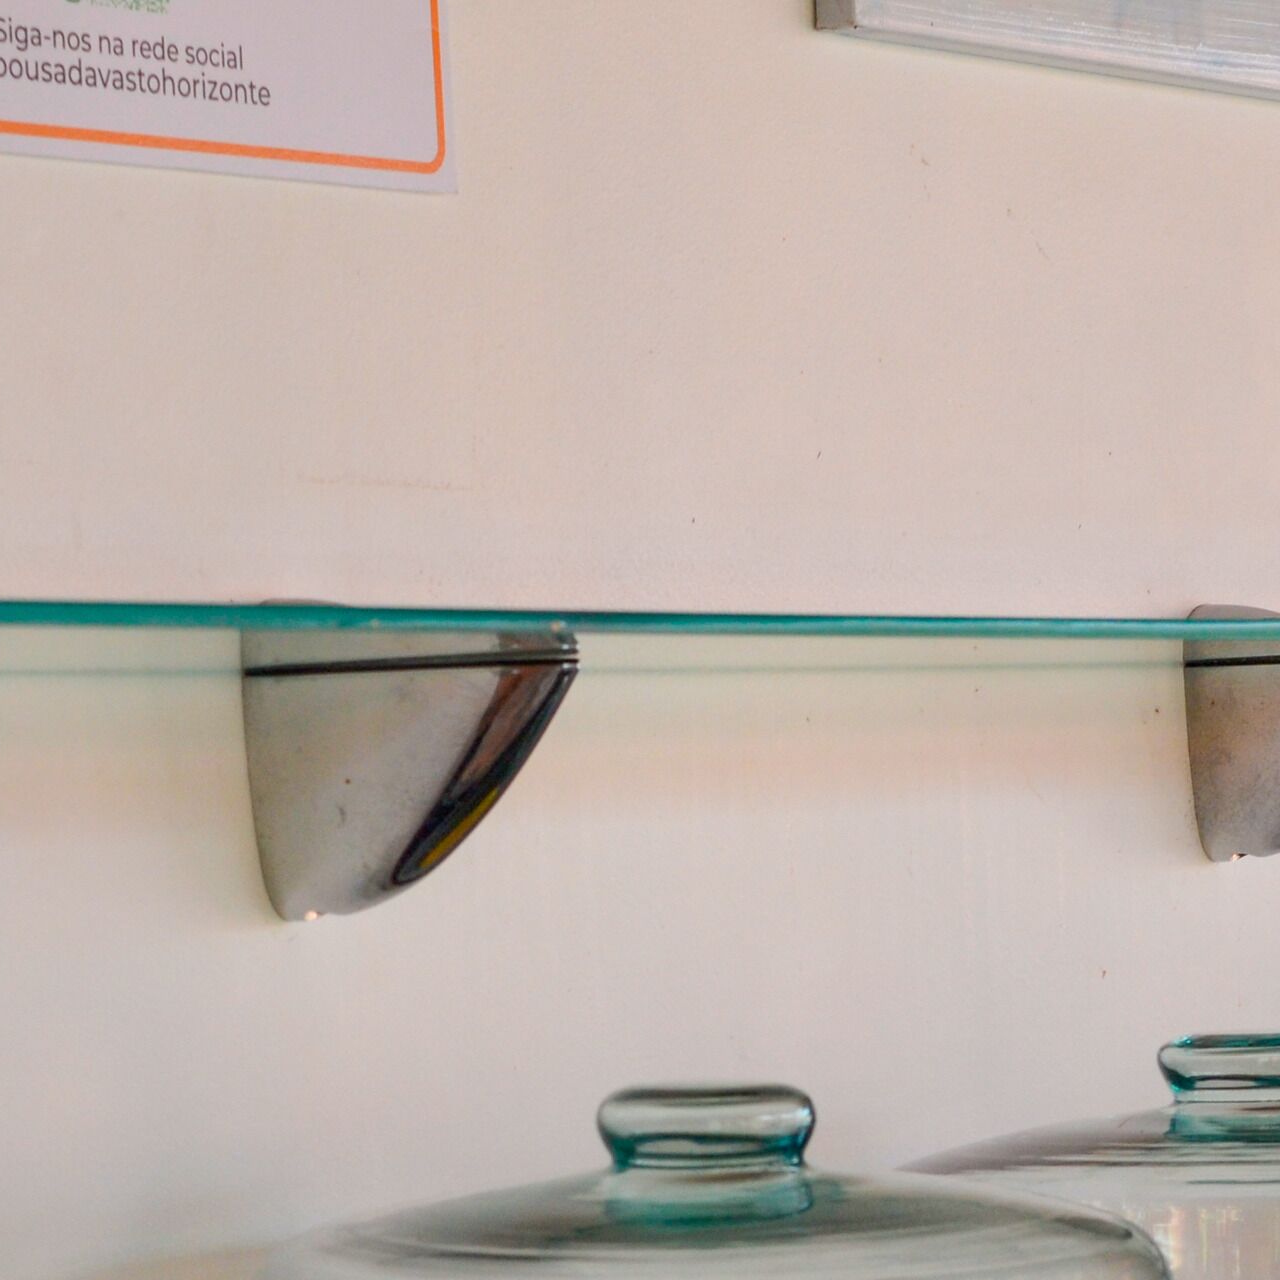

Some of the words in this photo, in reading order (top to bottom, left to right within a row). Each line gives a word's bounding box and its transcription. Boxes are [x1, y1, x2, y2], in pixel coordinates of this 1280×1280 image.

[99, 35, 124, 56] na
[132, 35, 179, 63] rede
[185, 42, 244, 71] social
